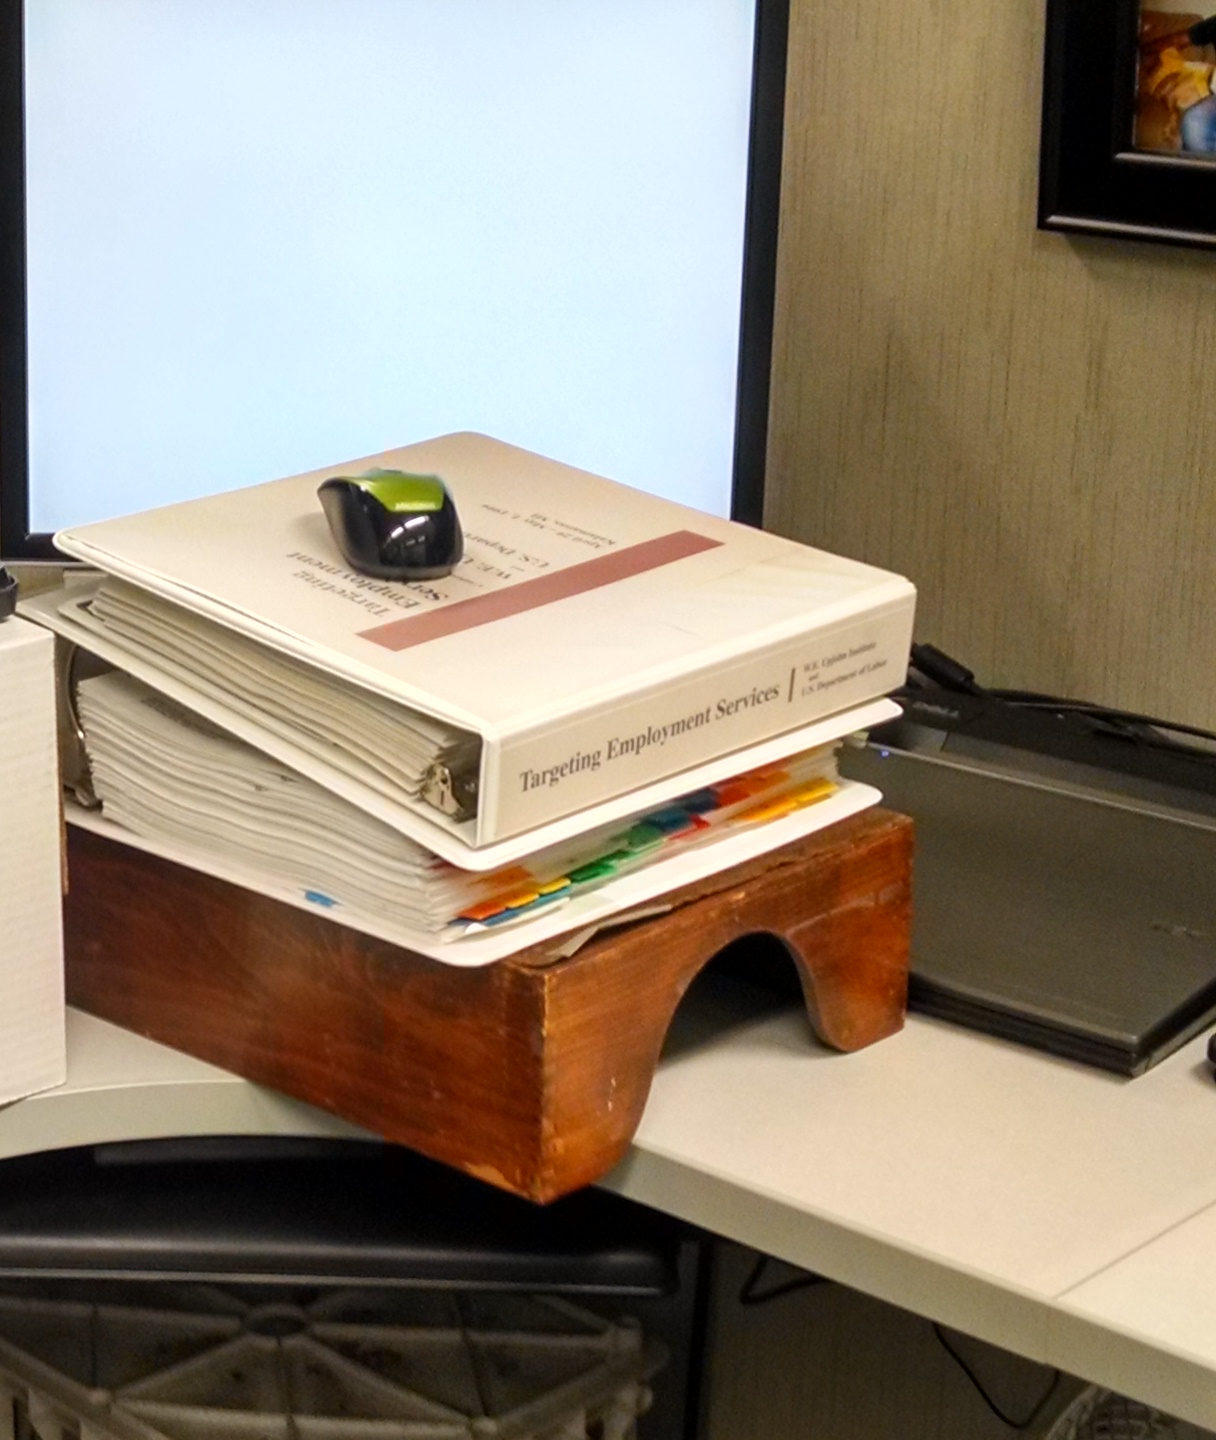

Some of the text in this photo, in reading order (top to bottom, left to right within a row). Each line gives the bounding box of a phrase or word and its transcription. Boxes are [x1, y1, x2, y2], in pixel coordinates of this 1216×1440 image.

[464, 533, 516, 555] Depart
[286, 552, 420, 609] Employment
[292, 570, 390, 618] Targeting
[817, 670, 857, 691] Department
[867, 659, 887, 672] Labor
[519, 681, 780, 794] Targeting Employment Services
